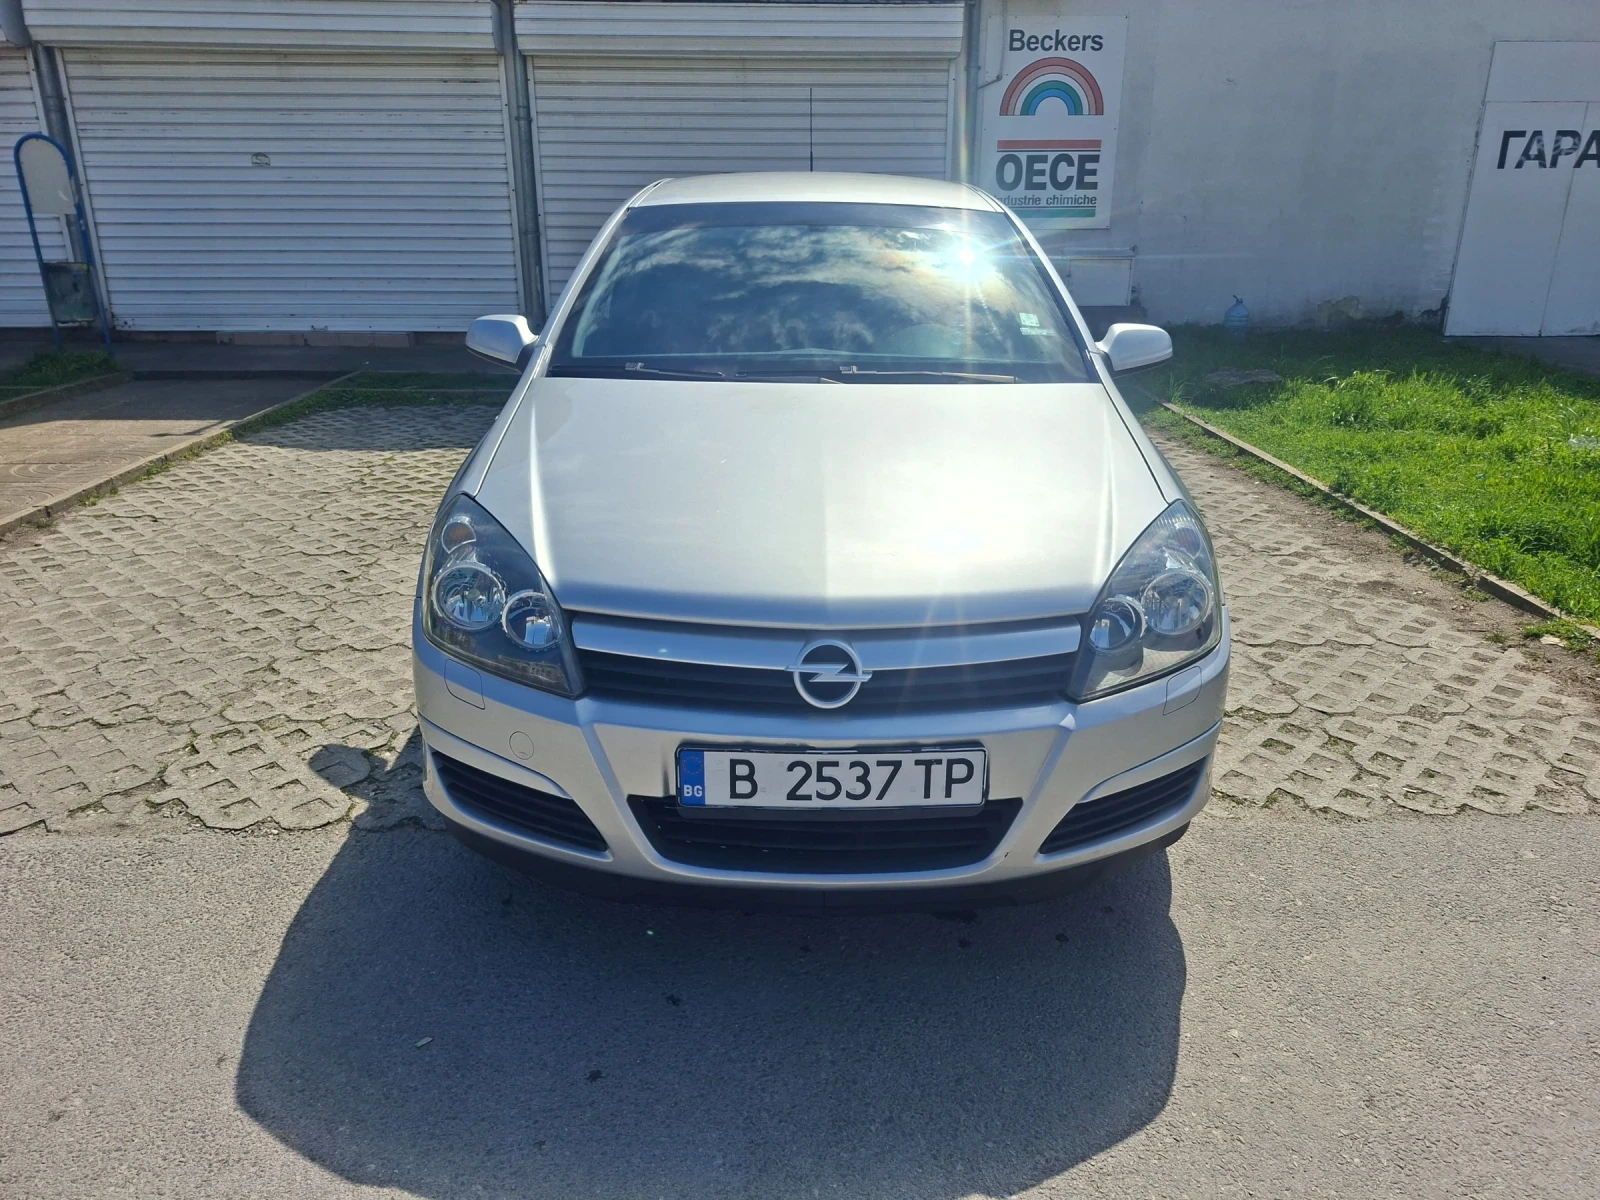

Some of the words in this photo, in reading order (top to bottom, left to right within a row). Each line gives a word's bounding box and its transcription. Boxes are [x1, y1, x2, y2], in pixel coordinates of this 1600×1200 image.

[1009, 29, 1104, 51] Beckers
[995, 153, 1100, 191] OECE
[994, 194, 1041, 206] dustrie
[1046, 194, 1097, 206] chimiche
[683, 784, 703, 797] BG
[729, 758, 758, 799] B
[786, 760, 903, 801] 2537
[914, 758, 974, 799] TP
